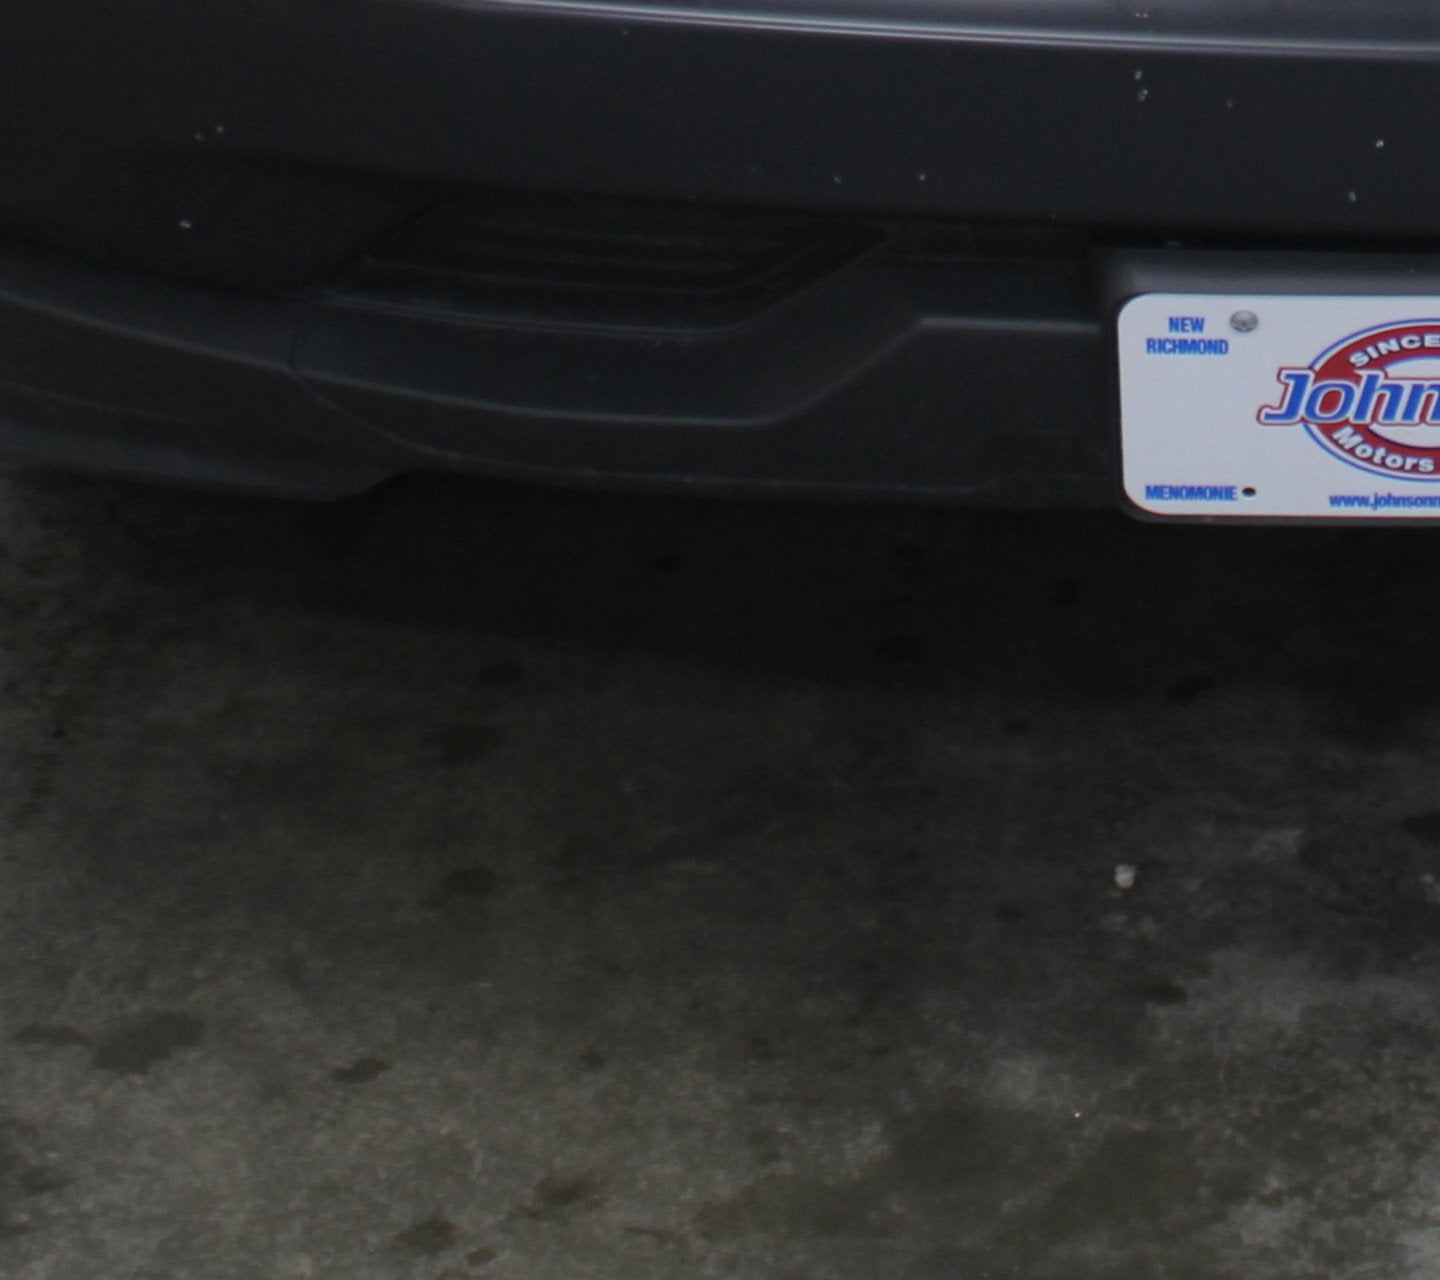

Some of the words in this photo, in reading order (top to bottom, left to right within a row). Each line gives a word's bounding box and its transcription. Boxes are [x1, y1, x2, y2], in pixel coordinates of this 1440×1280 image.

[1168, 316, 1205, 333] NEW
[1146, 337, 1229, 355] RICHMOND
[1331, 425, 1435, 473] Motors
[1146, 484, 1238, 501] MENOMONIE
